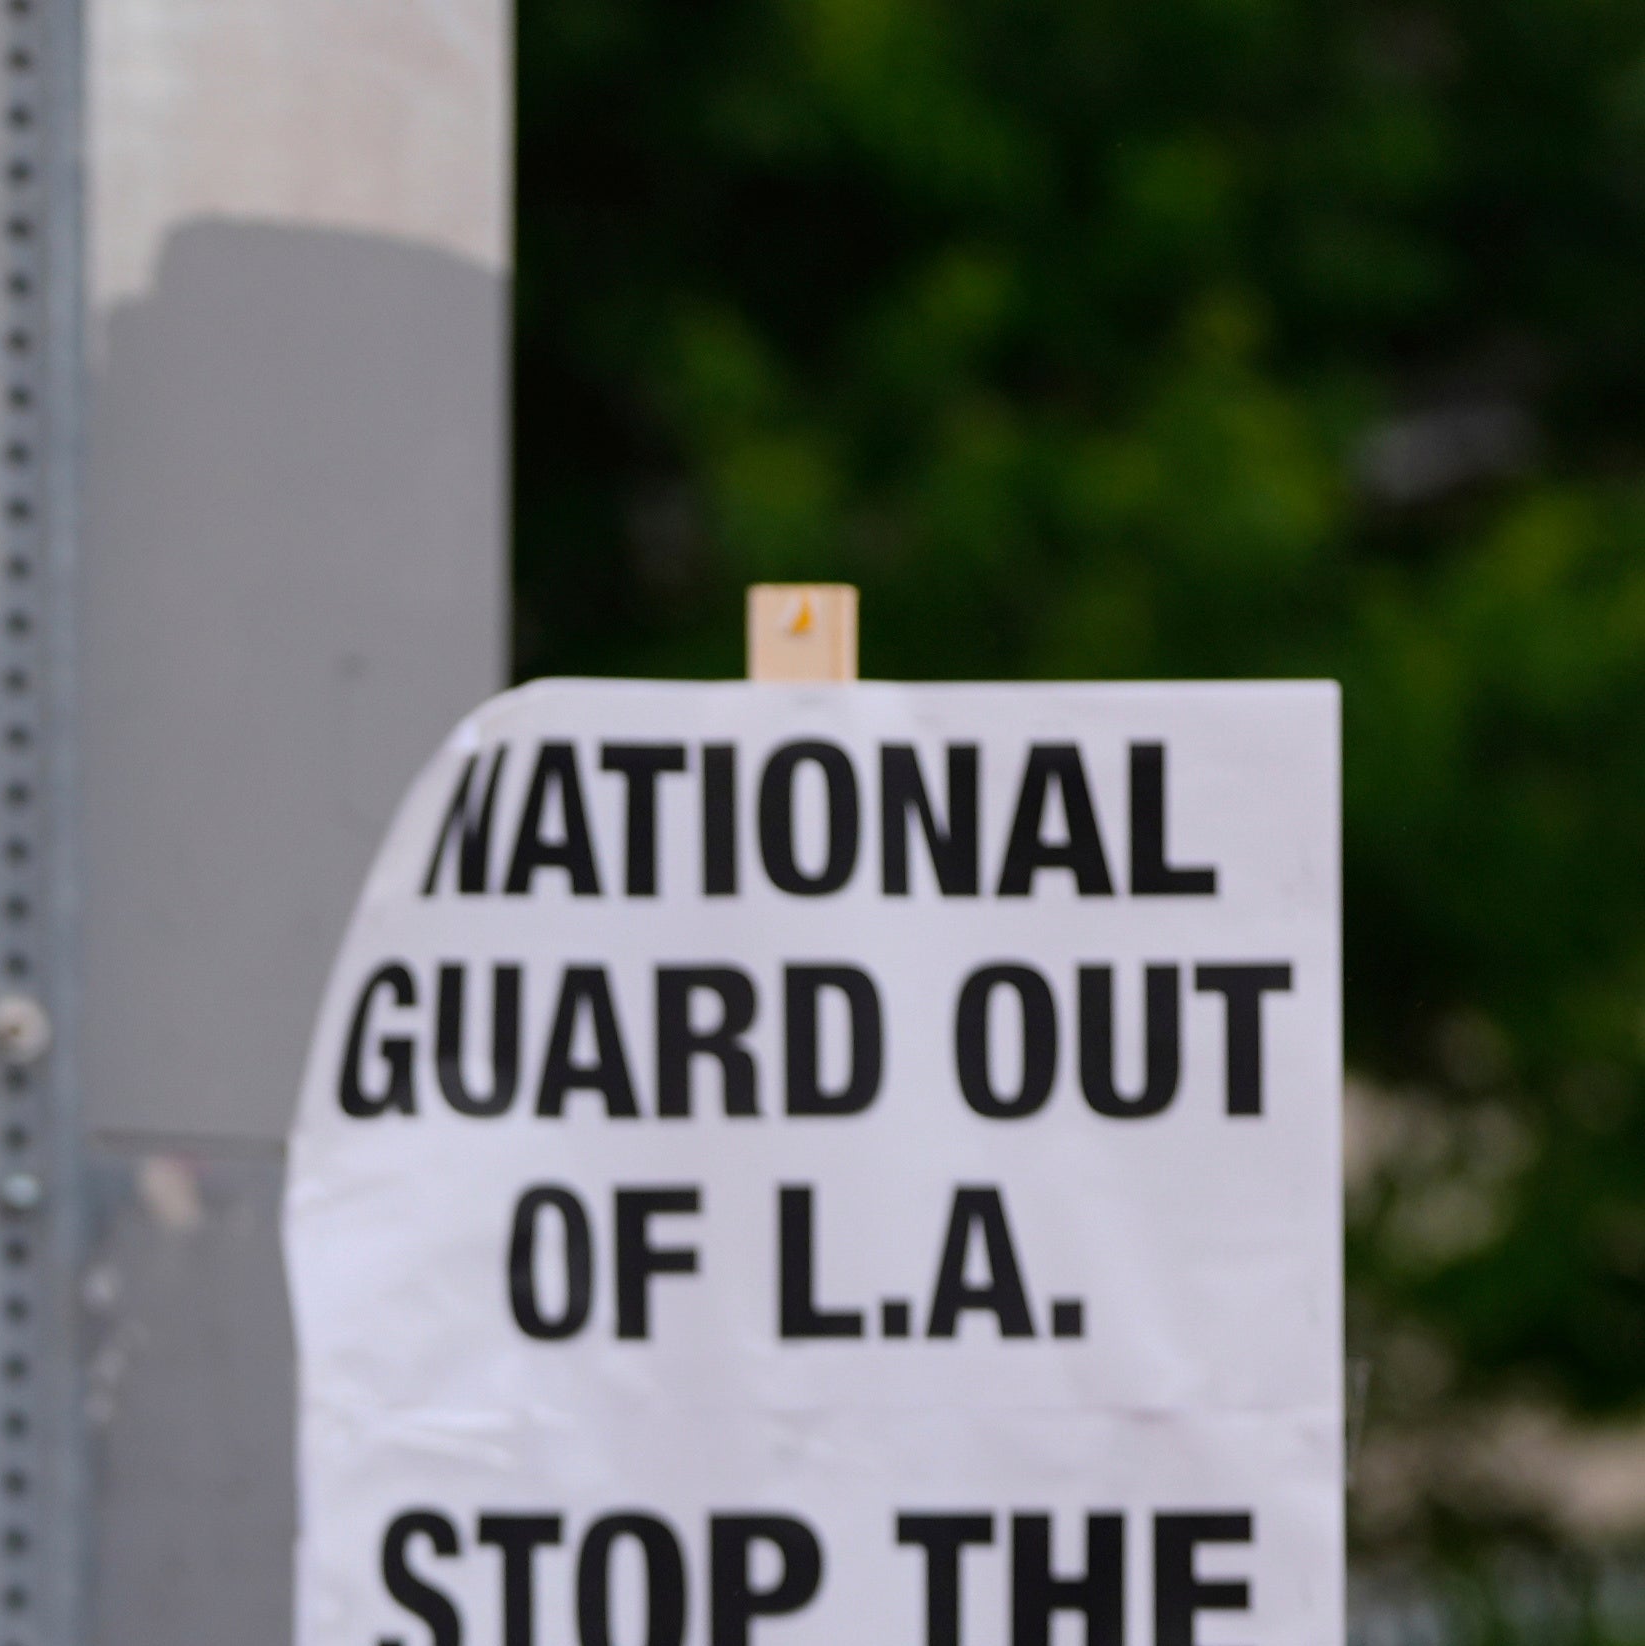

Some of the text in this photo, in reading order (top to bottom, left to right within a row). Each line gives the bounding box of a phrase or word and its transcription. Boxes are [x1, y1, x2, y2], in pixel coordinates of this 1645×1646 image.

[422, 739, 1217, 898] NATIONAL
[337, 961, 1293, 1120] GUARD OUT
[507, 1185, 1084, 1342] OF L.A.
